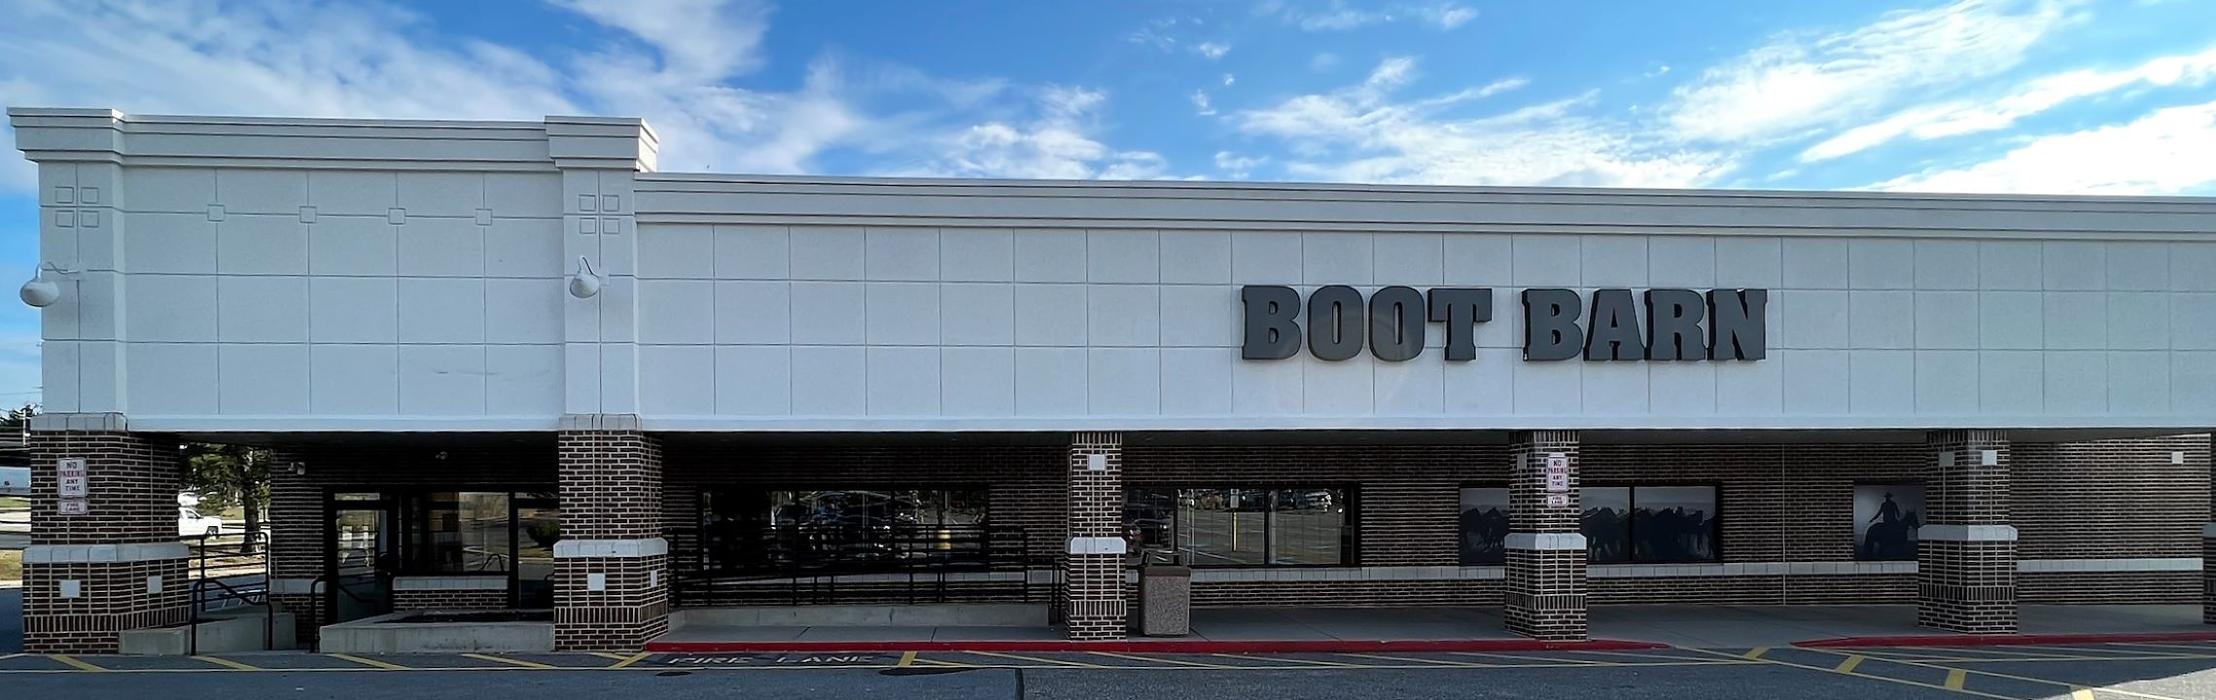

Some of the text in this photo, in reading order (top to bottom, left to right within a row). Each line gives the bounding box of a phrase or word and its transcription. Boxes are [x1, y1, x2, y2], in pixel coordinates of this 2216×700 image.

[1242, 285, 1767, 361] BOOT BARN
[66, 461, 78, 469] NO
